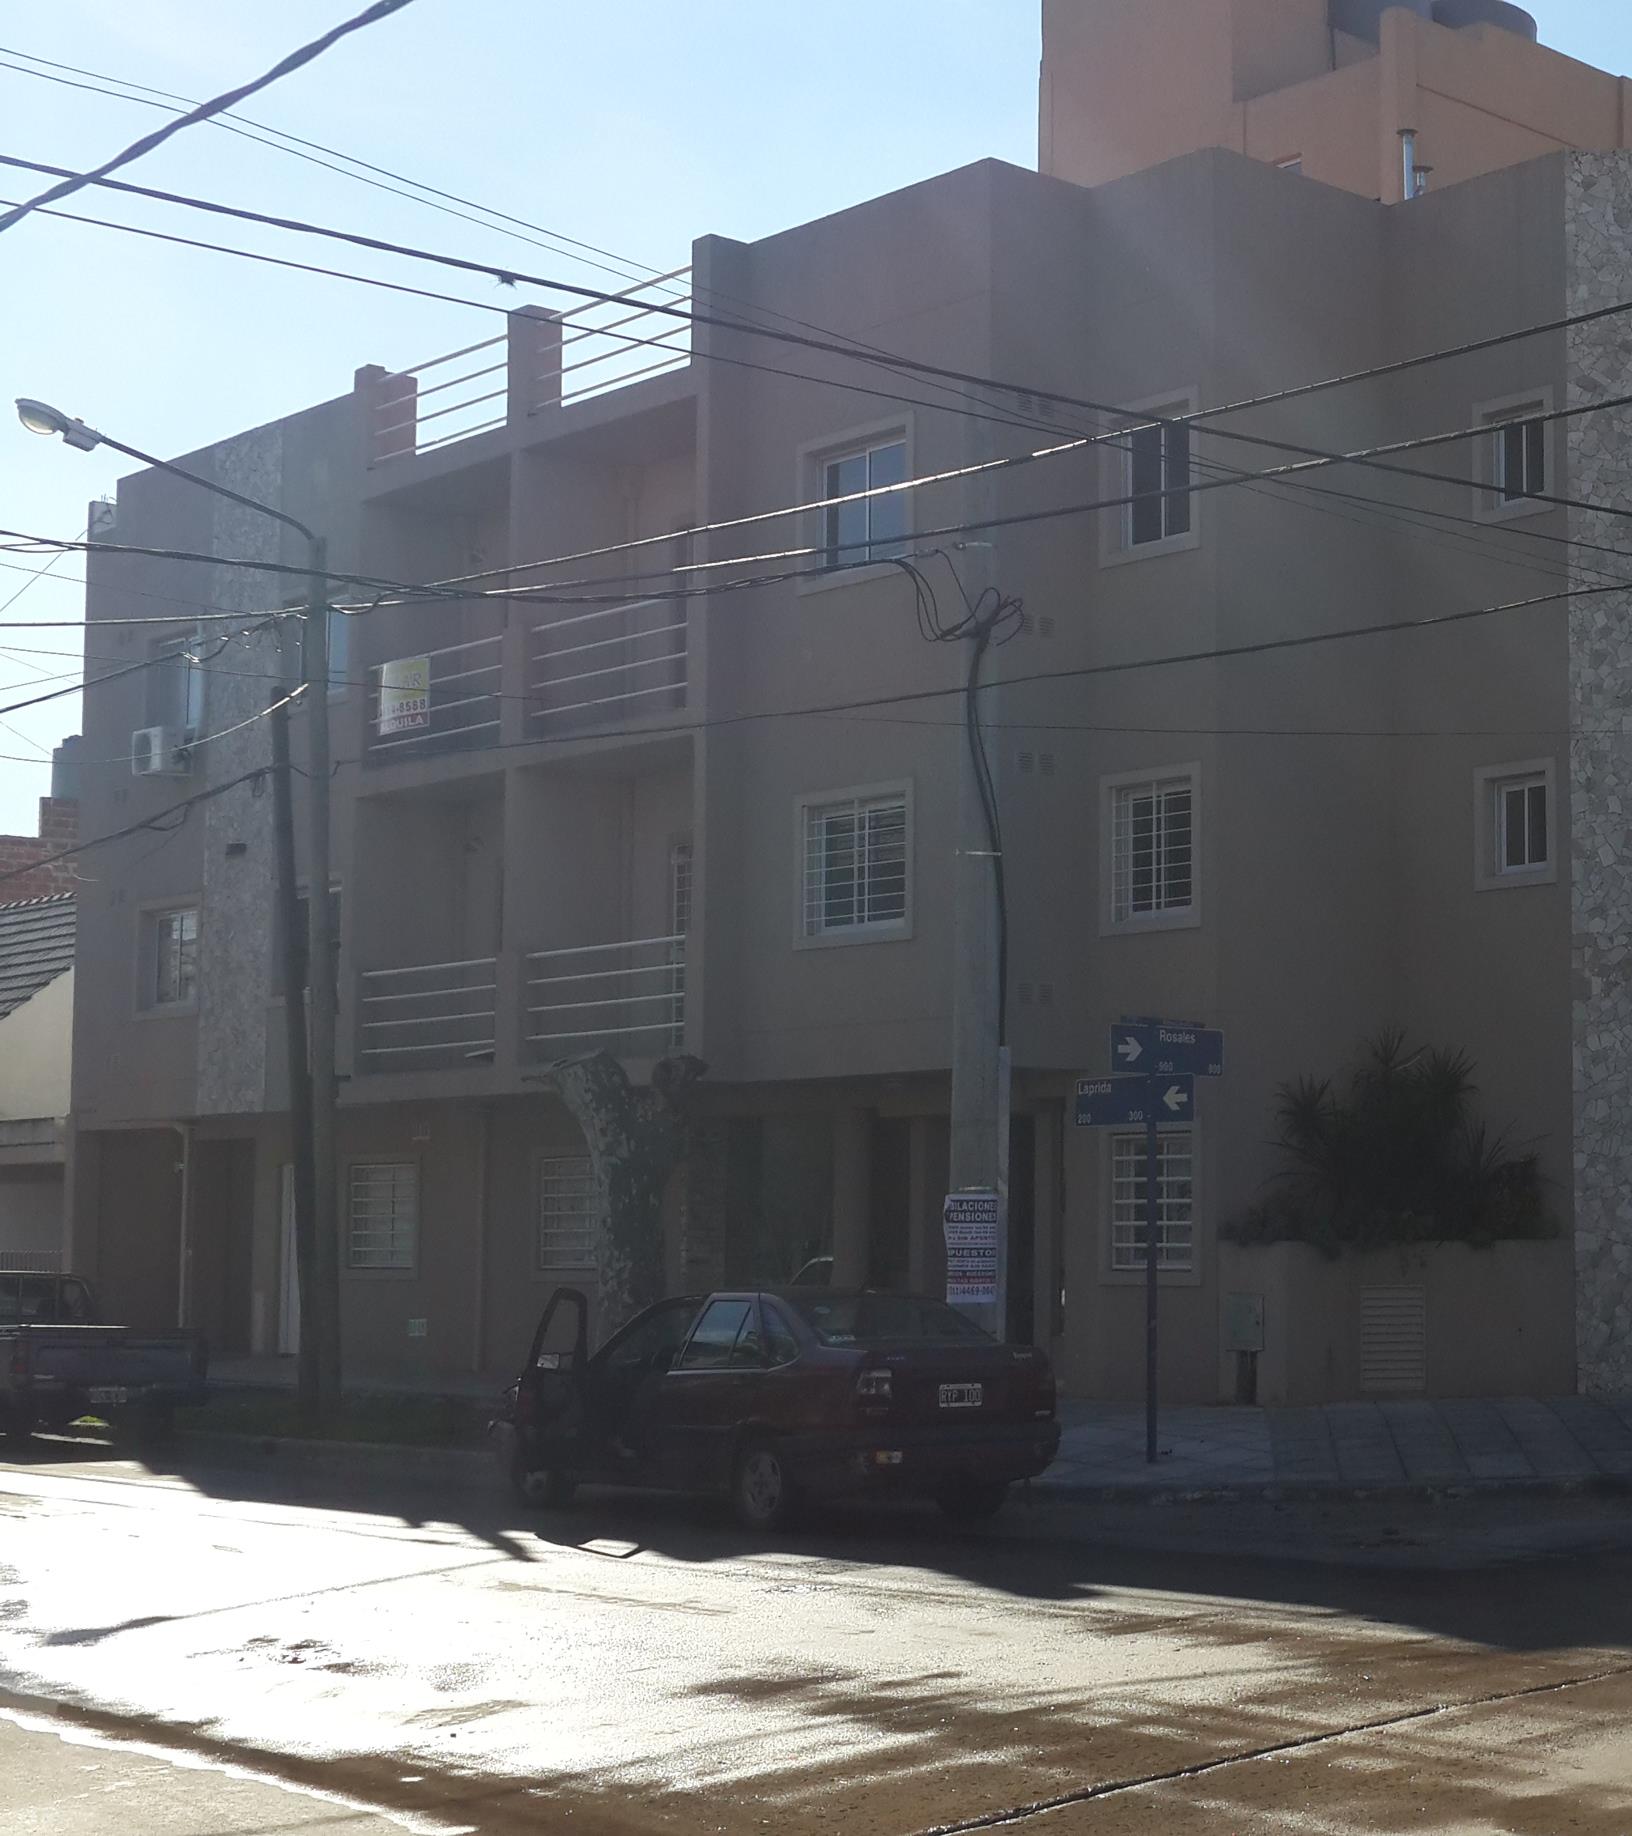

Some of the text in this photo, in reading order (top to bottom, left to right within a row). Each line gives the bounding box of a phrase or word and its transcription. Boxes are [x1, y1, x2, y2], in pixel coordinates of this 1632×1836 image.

[1159, 1029, 1196, 1045] Rosales
[1078, 1081, 1112, 1097] Laprida
[1077, 1110, 1143, 1124] 200 300
[963, 1389, 981, 1402] 100
